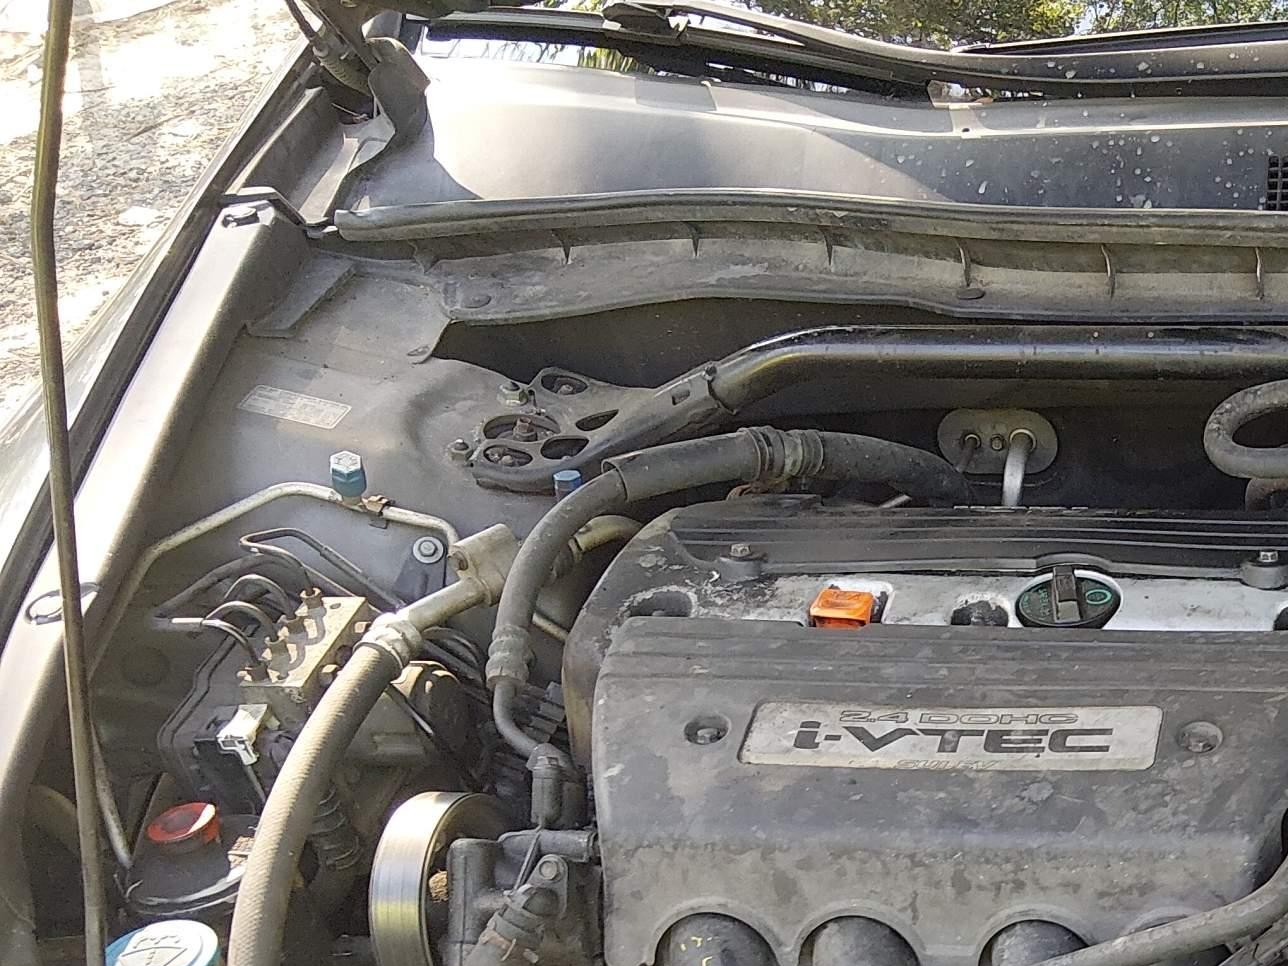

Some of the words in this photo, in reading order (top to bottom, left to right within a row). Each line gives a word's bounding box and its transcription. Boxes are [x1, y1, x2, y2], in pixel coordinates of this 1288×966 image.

[839, 710, 909, 724] 2.4
[918, 711, 1079, 725] DOHC
[792, 720, 1115, 753] i-VTEC
